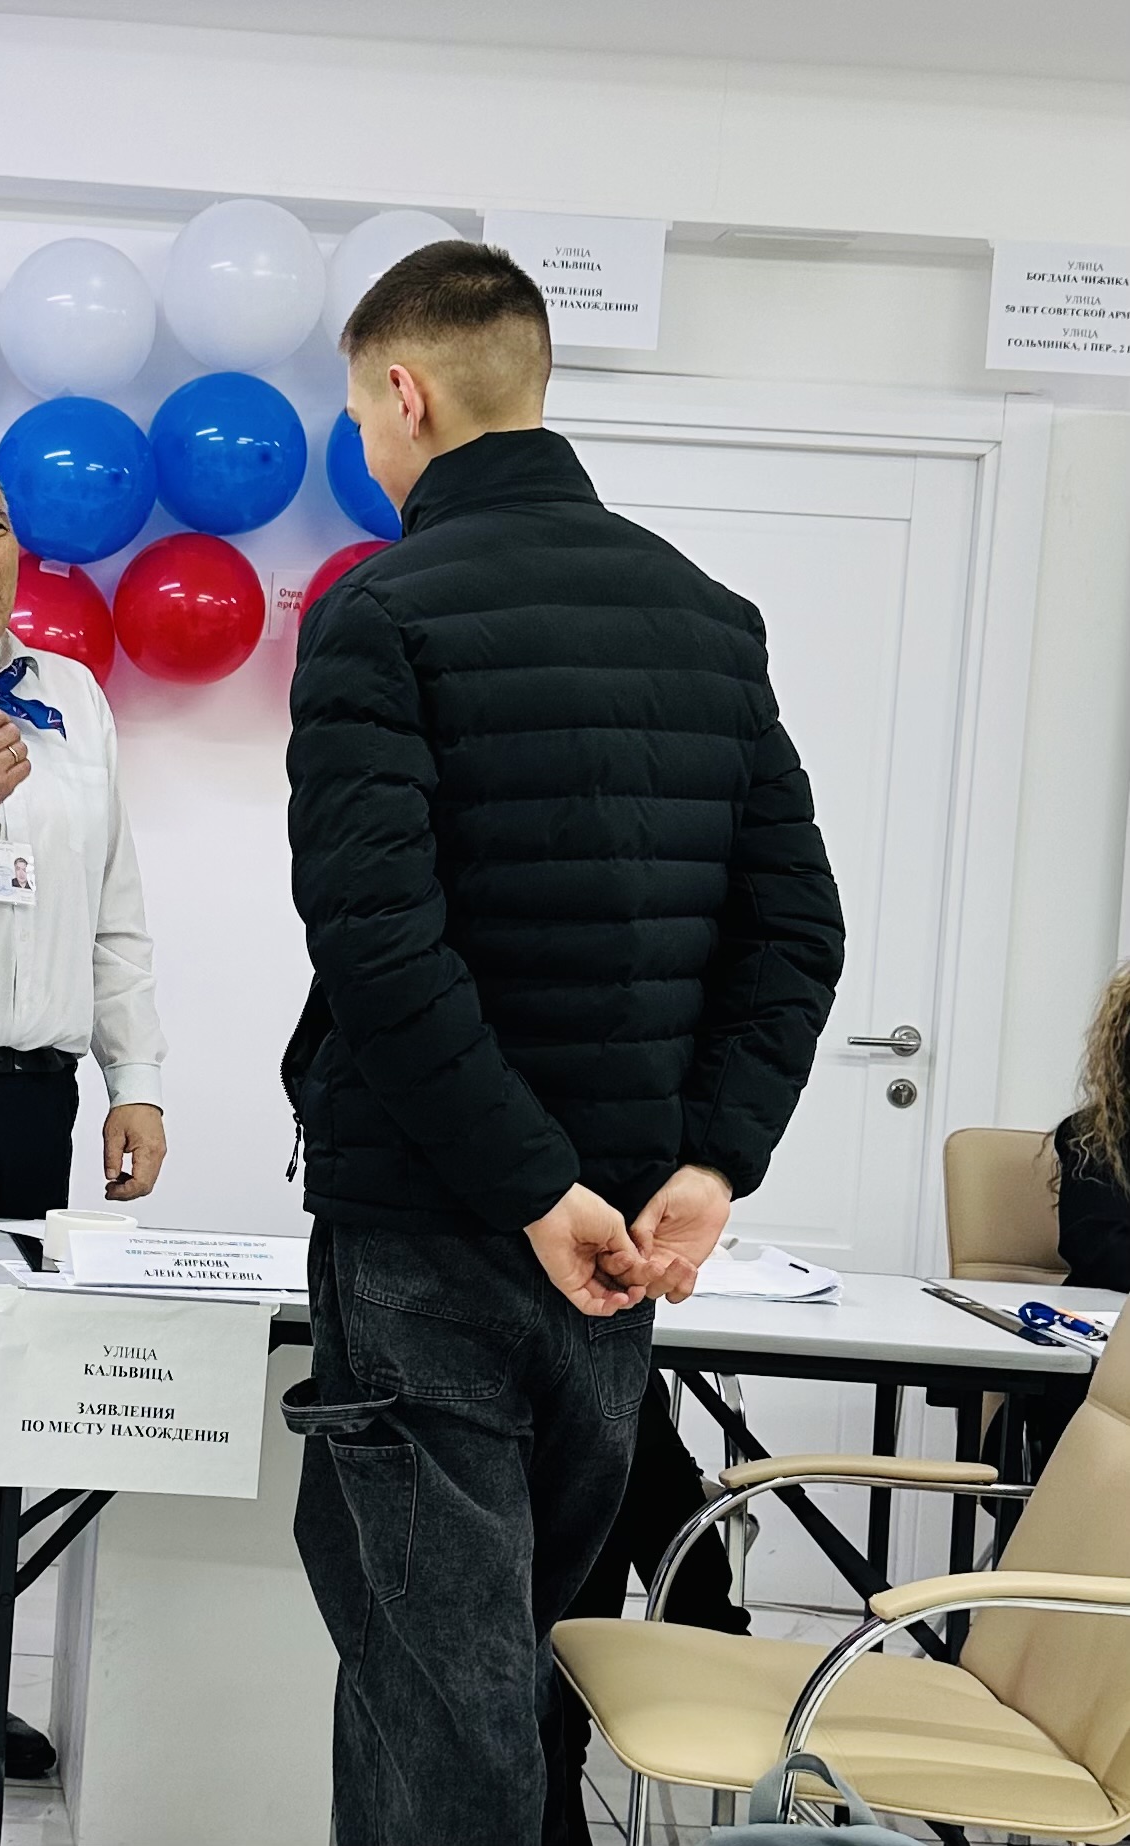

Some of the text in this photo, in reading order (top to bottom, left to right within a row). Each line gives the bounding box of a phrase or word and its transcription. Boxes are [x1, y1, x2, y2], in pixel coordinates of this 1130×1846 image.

[555, 246, 591, 258] УЛИЦА
[542, 259, 602, 271] КАЛЬВИЦА
[1067, 260, 1104, 272] УЛИЦА
[1026, 272, 1078, 284] БОГДАНА
[560, 299, 639, 312] НАХОЖДЕНИЯ
[1065, 294, 1101, 305] УЛИЦА
[1005, 304, 1016, 313] 50
[1018, 305, 1039, 315] ЛЕТ
[1040, 306, 1106, 319] СОВЕТСКОЙ
[1062, 327, 1099, 339] УЛИЦА
[1007, 338, 1081, 352] ГОЛЬМИНКА,
[1119, 345, 1125, 354] 2
[172, 1258, 229, 1268] ЖИРКОВА
[144, 1268, 263, 1281] АЛЕНА АЛЕКСЕЕВНА
[103, 1345, 158, 1362] УЛИЦА
[84, 1363, 174, 1382] КАЛЬВИЦА
[77, 1402, 175, 1420] ЗАЯВЛЕНИЯ
[21, 1419, 230, 1444] ПО МЕСТУ НАХОЖДЕНИЯ
